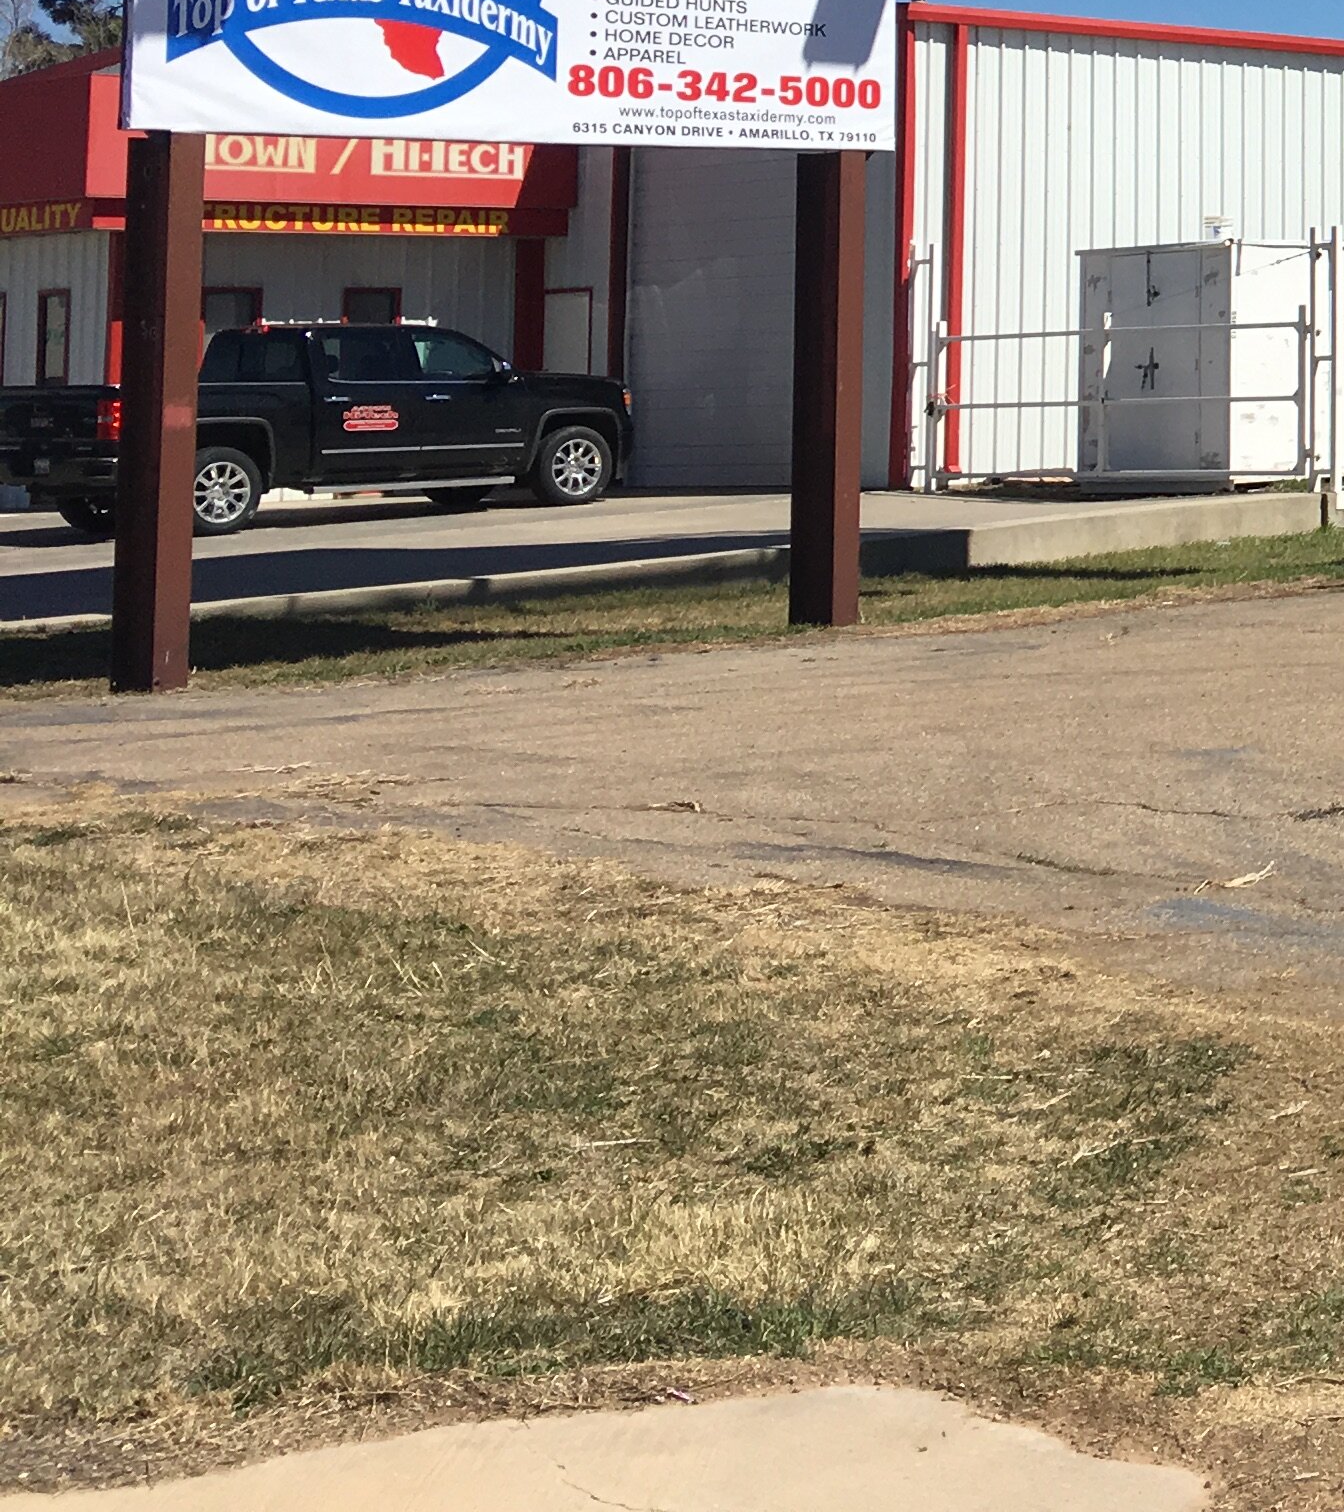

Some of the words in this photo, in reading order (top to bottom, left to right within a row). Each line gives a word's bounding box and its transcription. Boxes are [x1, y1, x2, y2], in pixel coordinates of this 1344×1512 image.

[604, 10, 688, 29] CUSTOM
[694, 15, 827, 38] LEATHERWORK
[604, 28, 663, 46] HOME
[669, 31, 735, 49] DECOR
[603, 46, 686, 65] APPAREL
[567, 64, 881, 110] 806-342-5000
[618, 105, 837, 127] www.topoftexastaxidermy.com
[572, 122, 608, 135] 6315
[612, 123, 676, 137] CANYON
[681, 126, 723, 138] DRIVE
[738, 128, 814, 142] AMARILLO,
[819, 130, 834, 142] TX
[839, 131, 877, 143] 79110
[0, 202, 82, 233] UALITY
[392, 208, 509, 234] REPAIR
